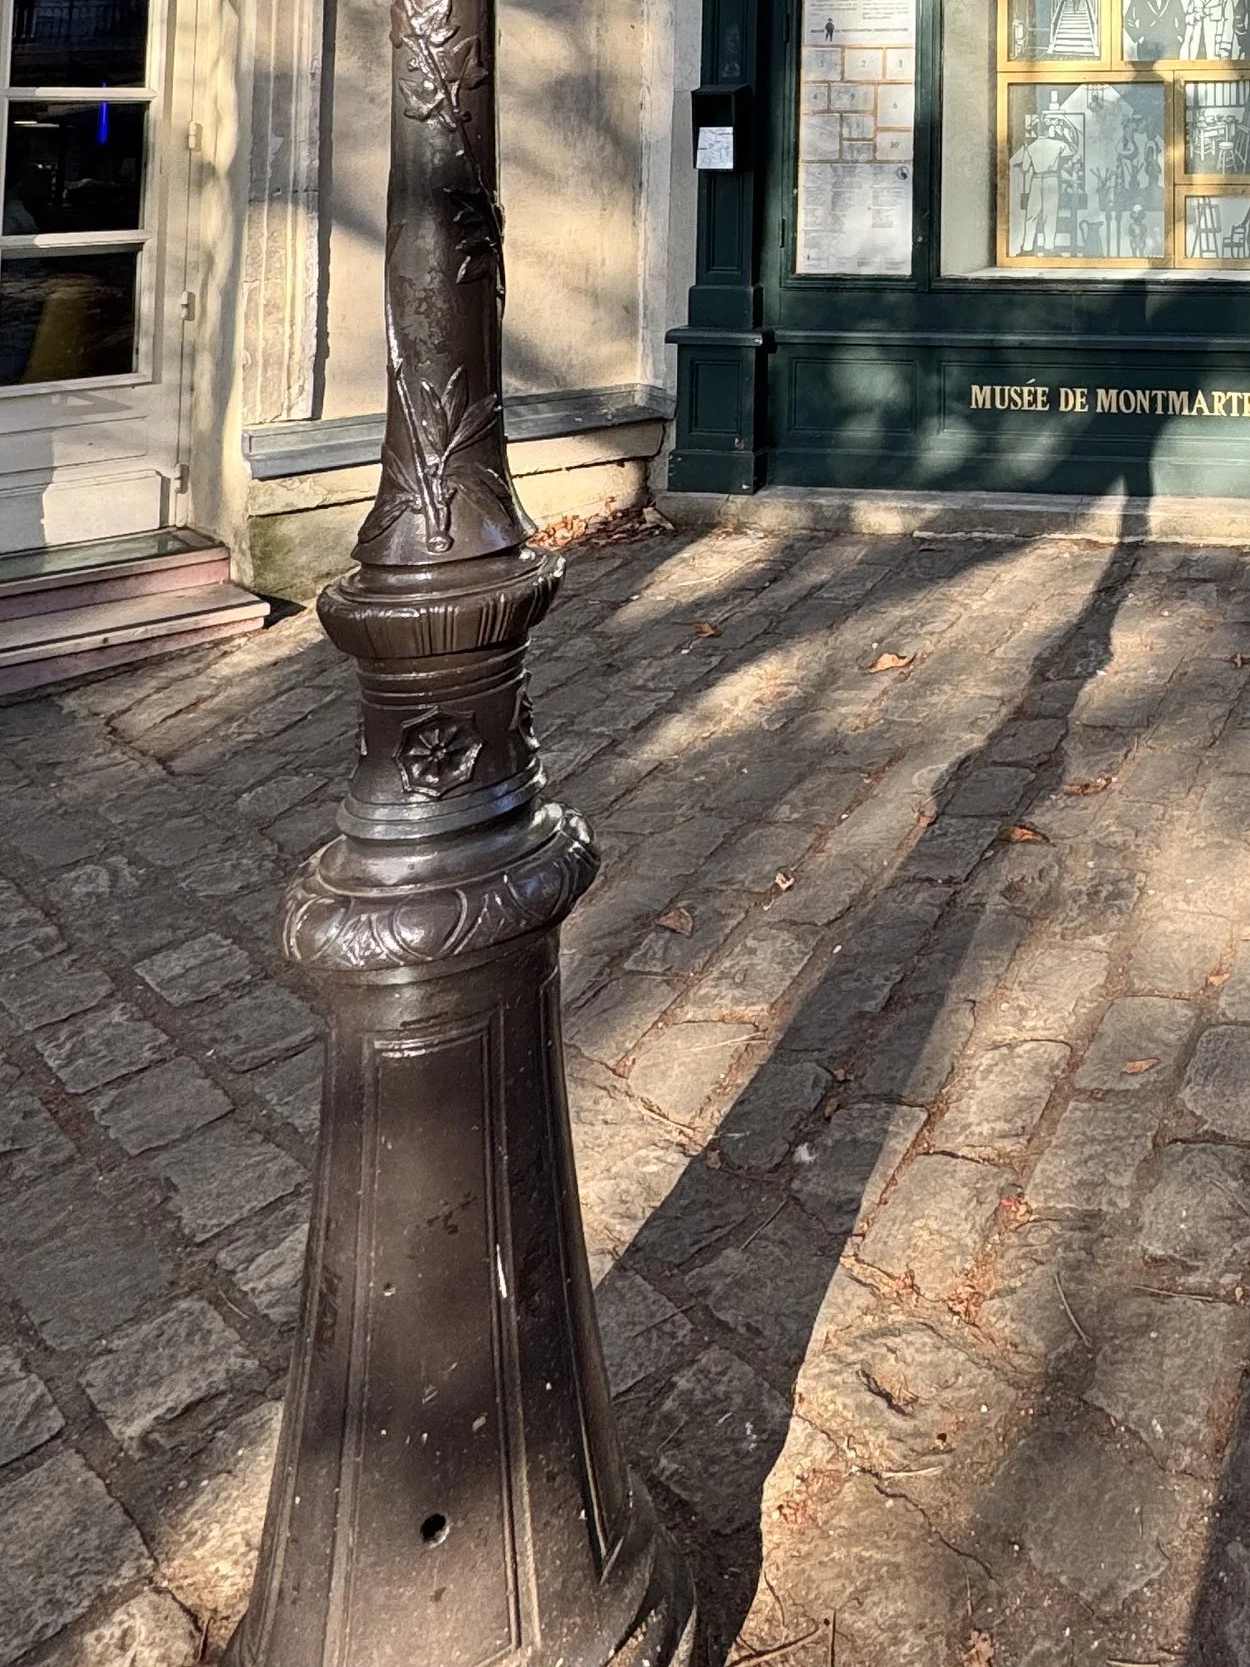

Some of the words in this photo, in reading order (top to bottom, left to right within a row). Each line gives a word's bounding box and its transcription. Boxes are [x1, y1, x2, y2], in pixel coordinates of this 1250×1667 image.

[889, 141, 900, 149] 10
[969, 378, 1050, 411] MUSÉE
[1059, 387, 1090, 412] DE
